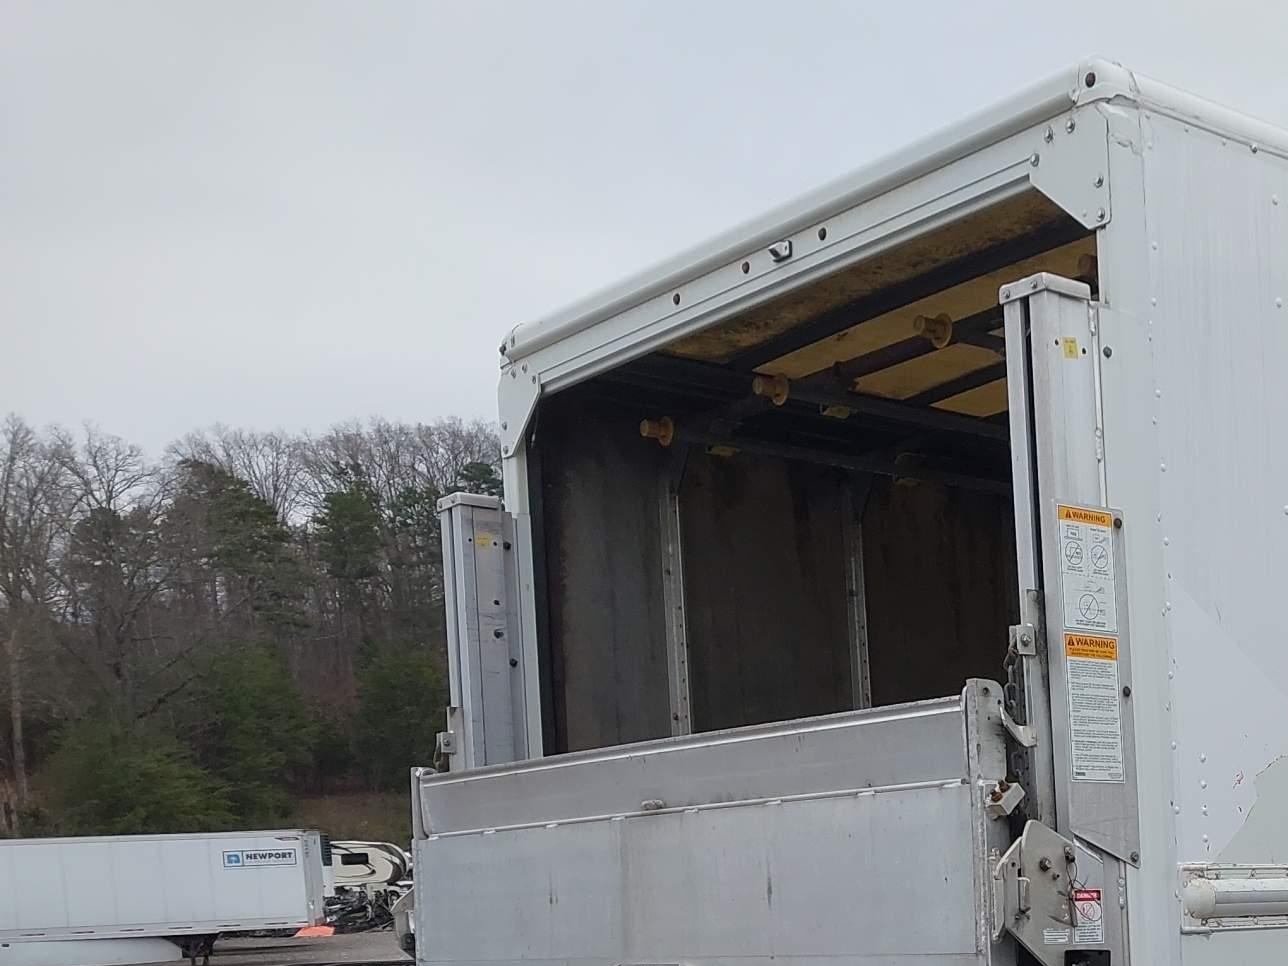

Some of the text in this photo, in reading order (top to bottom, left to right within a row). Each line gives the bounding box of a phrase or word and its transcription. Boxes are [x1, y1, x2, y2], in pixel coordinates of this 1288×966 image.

[1071, 511, 1106, 523] WARNING
[1075, 637, 1115, 649] WARNING
[246, 852, 293, 860] NEWPORT
